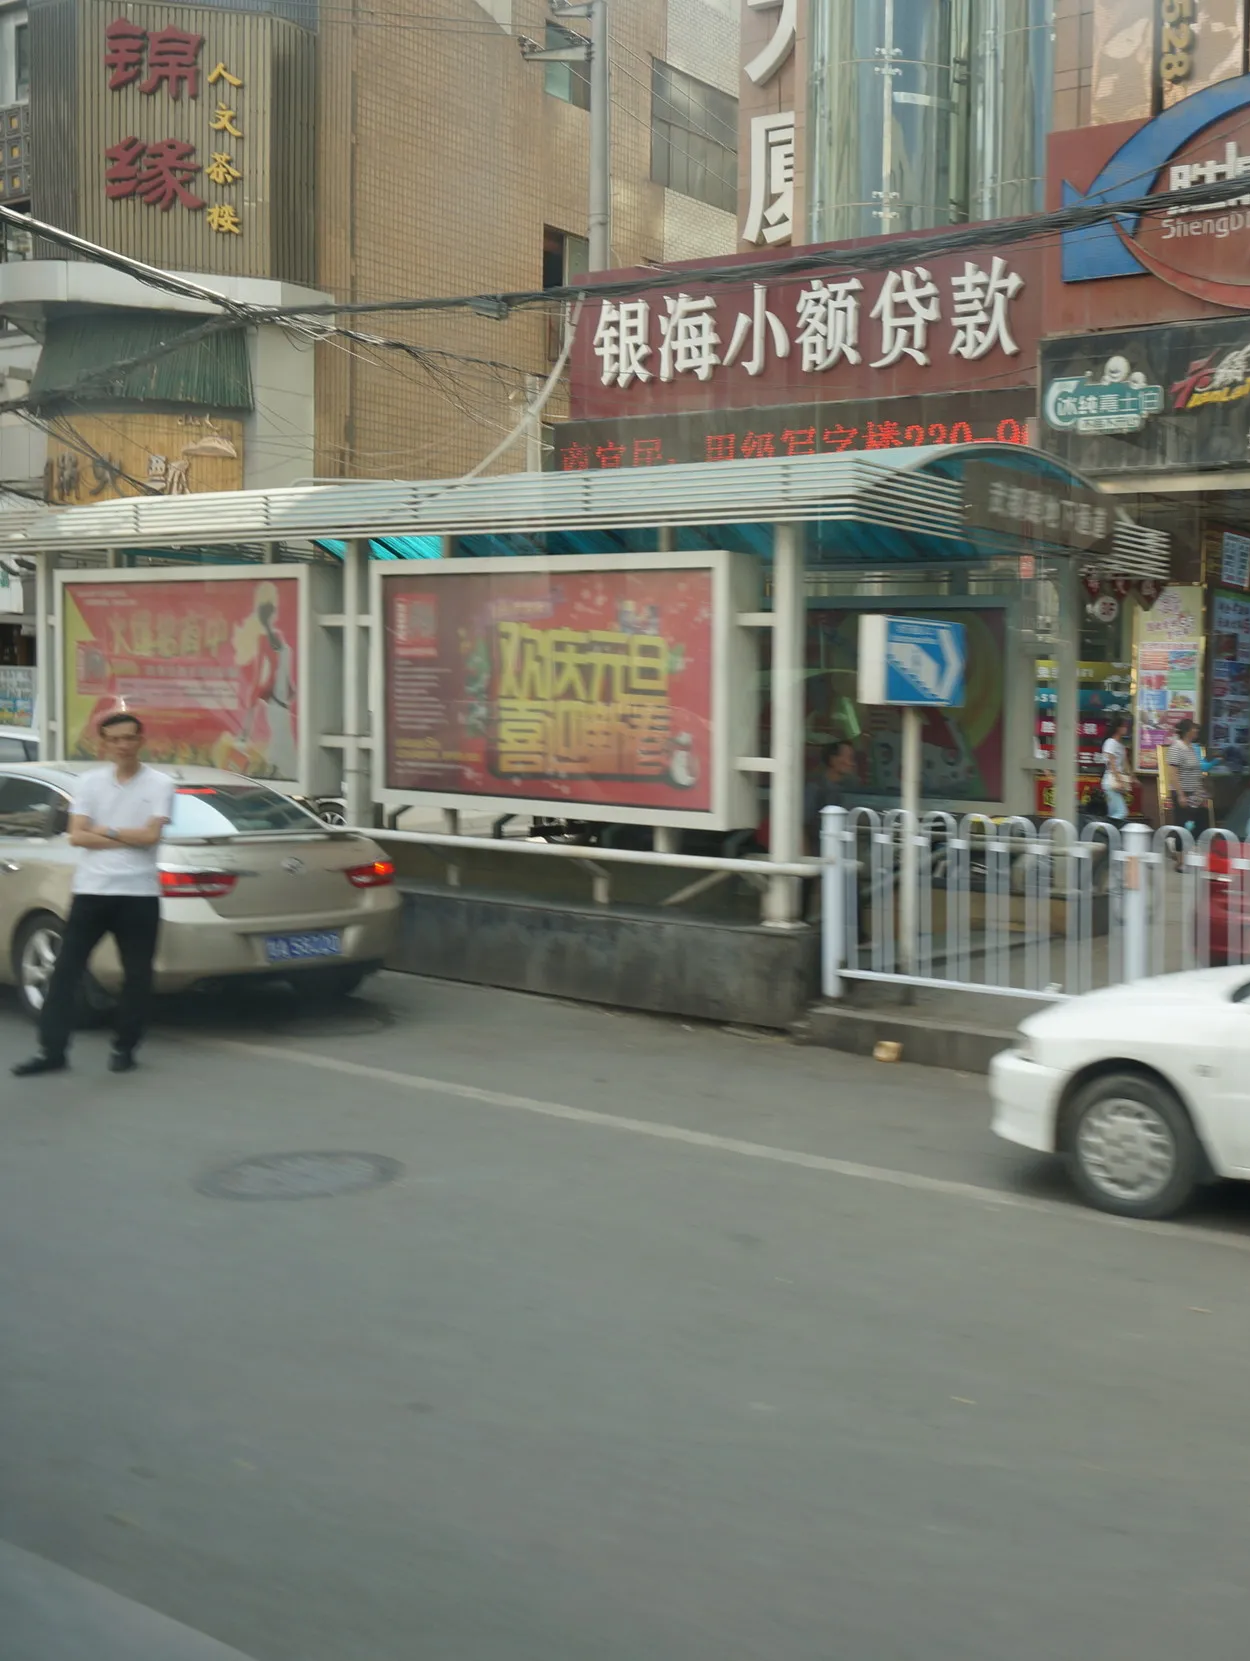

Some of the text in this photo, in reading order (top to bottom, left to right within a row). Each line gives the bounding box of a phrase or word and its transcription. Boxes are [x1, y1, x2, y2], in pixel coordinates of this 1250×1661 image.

[104, 16, 207, 212] 锦缘
[206, 62, 244, 236] 人文茶楼
[592, 255, 1026, 390] 银海小额贷款
